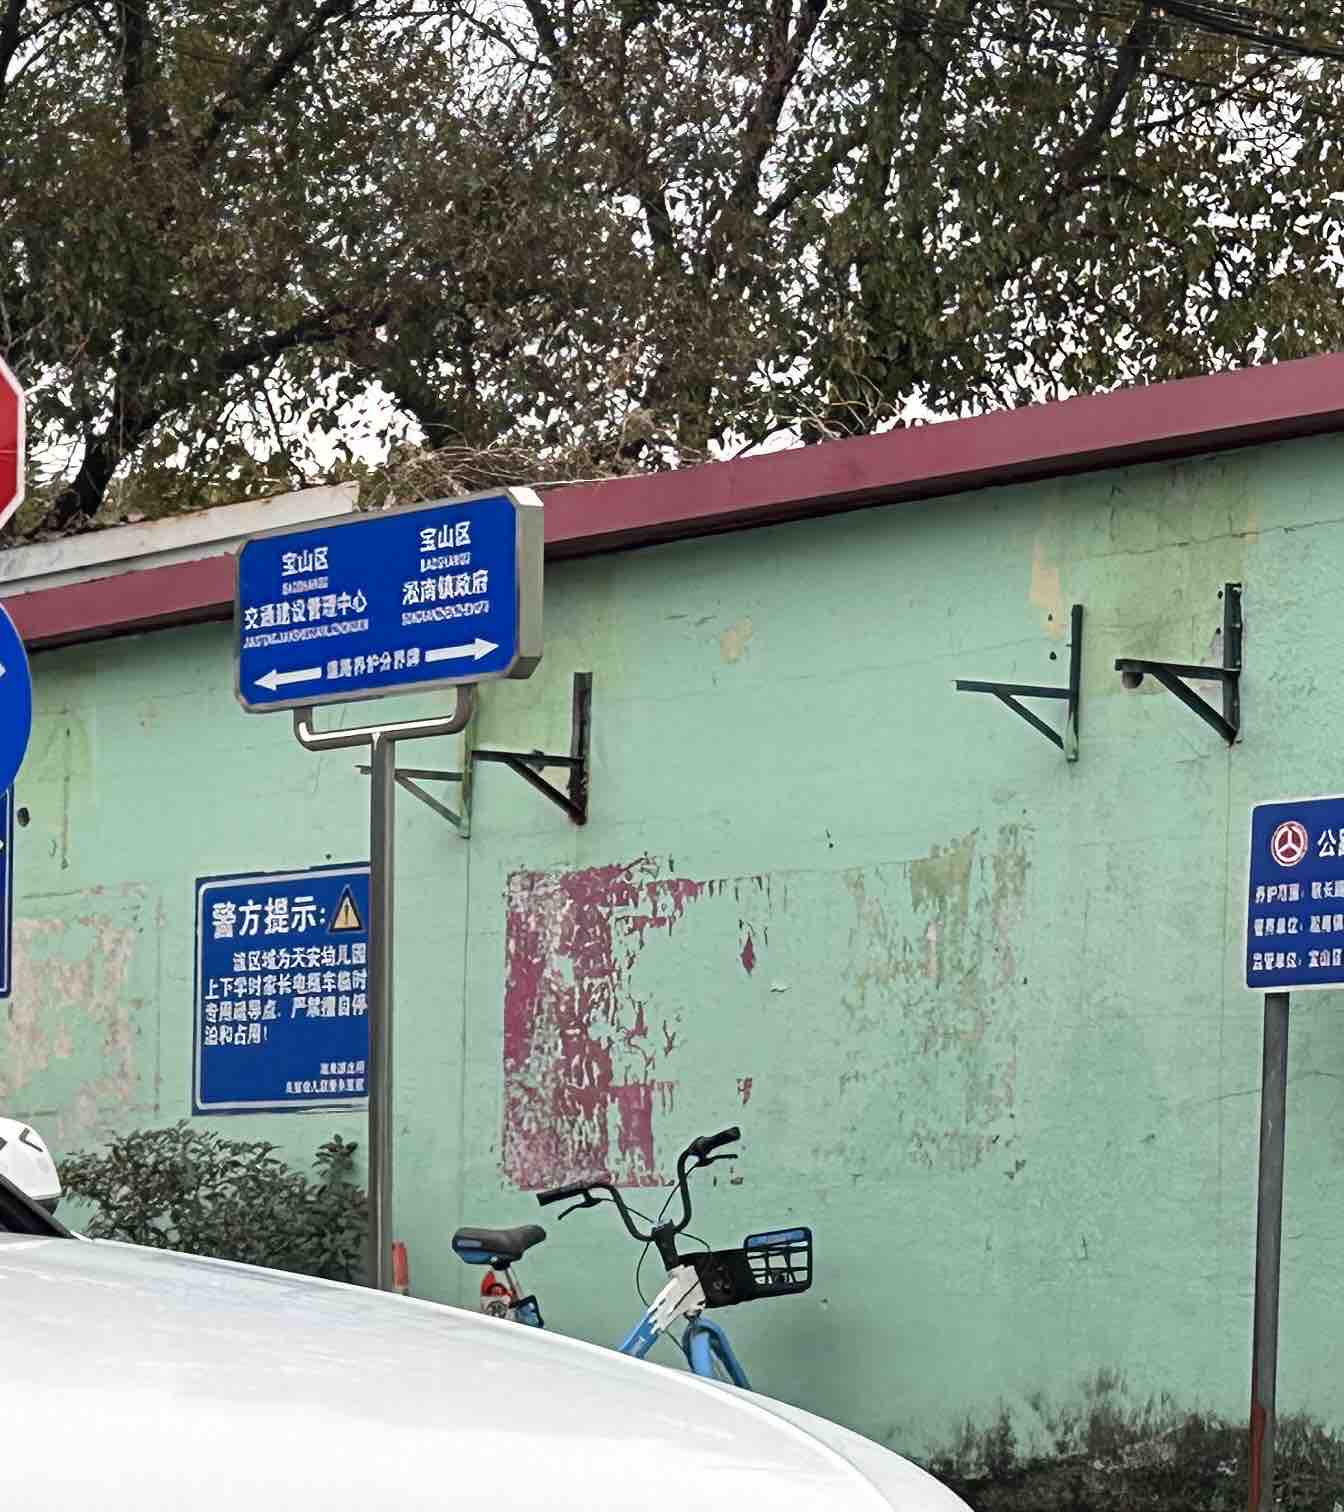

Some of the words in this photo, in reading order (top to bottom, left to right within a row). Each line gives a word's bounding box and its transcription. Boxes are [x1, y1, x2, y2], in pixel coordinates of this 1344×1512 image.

[419, 520, 471, 553] 宝山区
[280, 546, 329, 577] 宝山区
